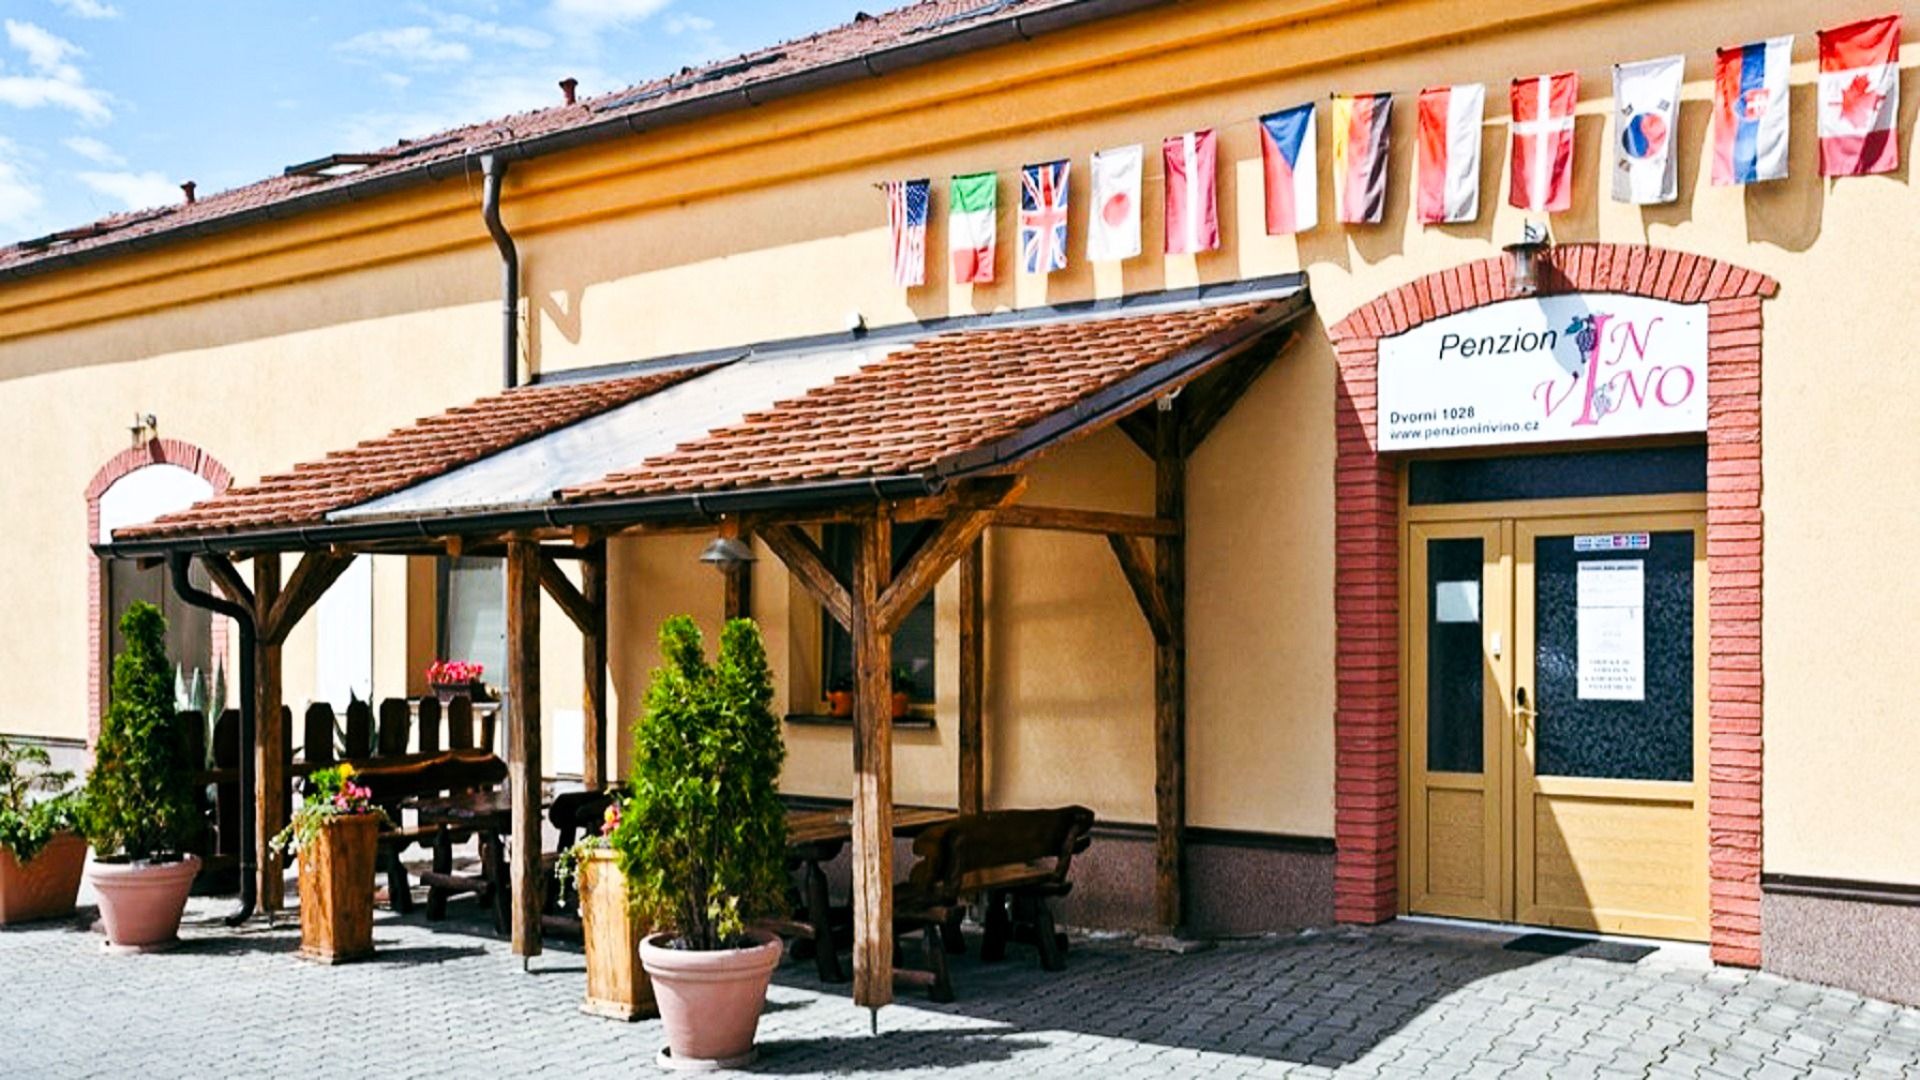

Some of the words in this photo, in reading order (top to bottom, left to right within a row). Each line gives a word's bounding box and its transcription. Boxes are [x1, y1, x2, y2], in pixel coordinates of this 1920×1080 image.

[1438, 326, 1558, 360] Penzion
[1442, 406, 1476, 421] 1028
[1389, 419, 1540, 441] www.penzioninvino.cz
